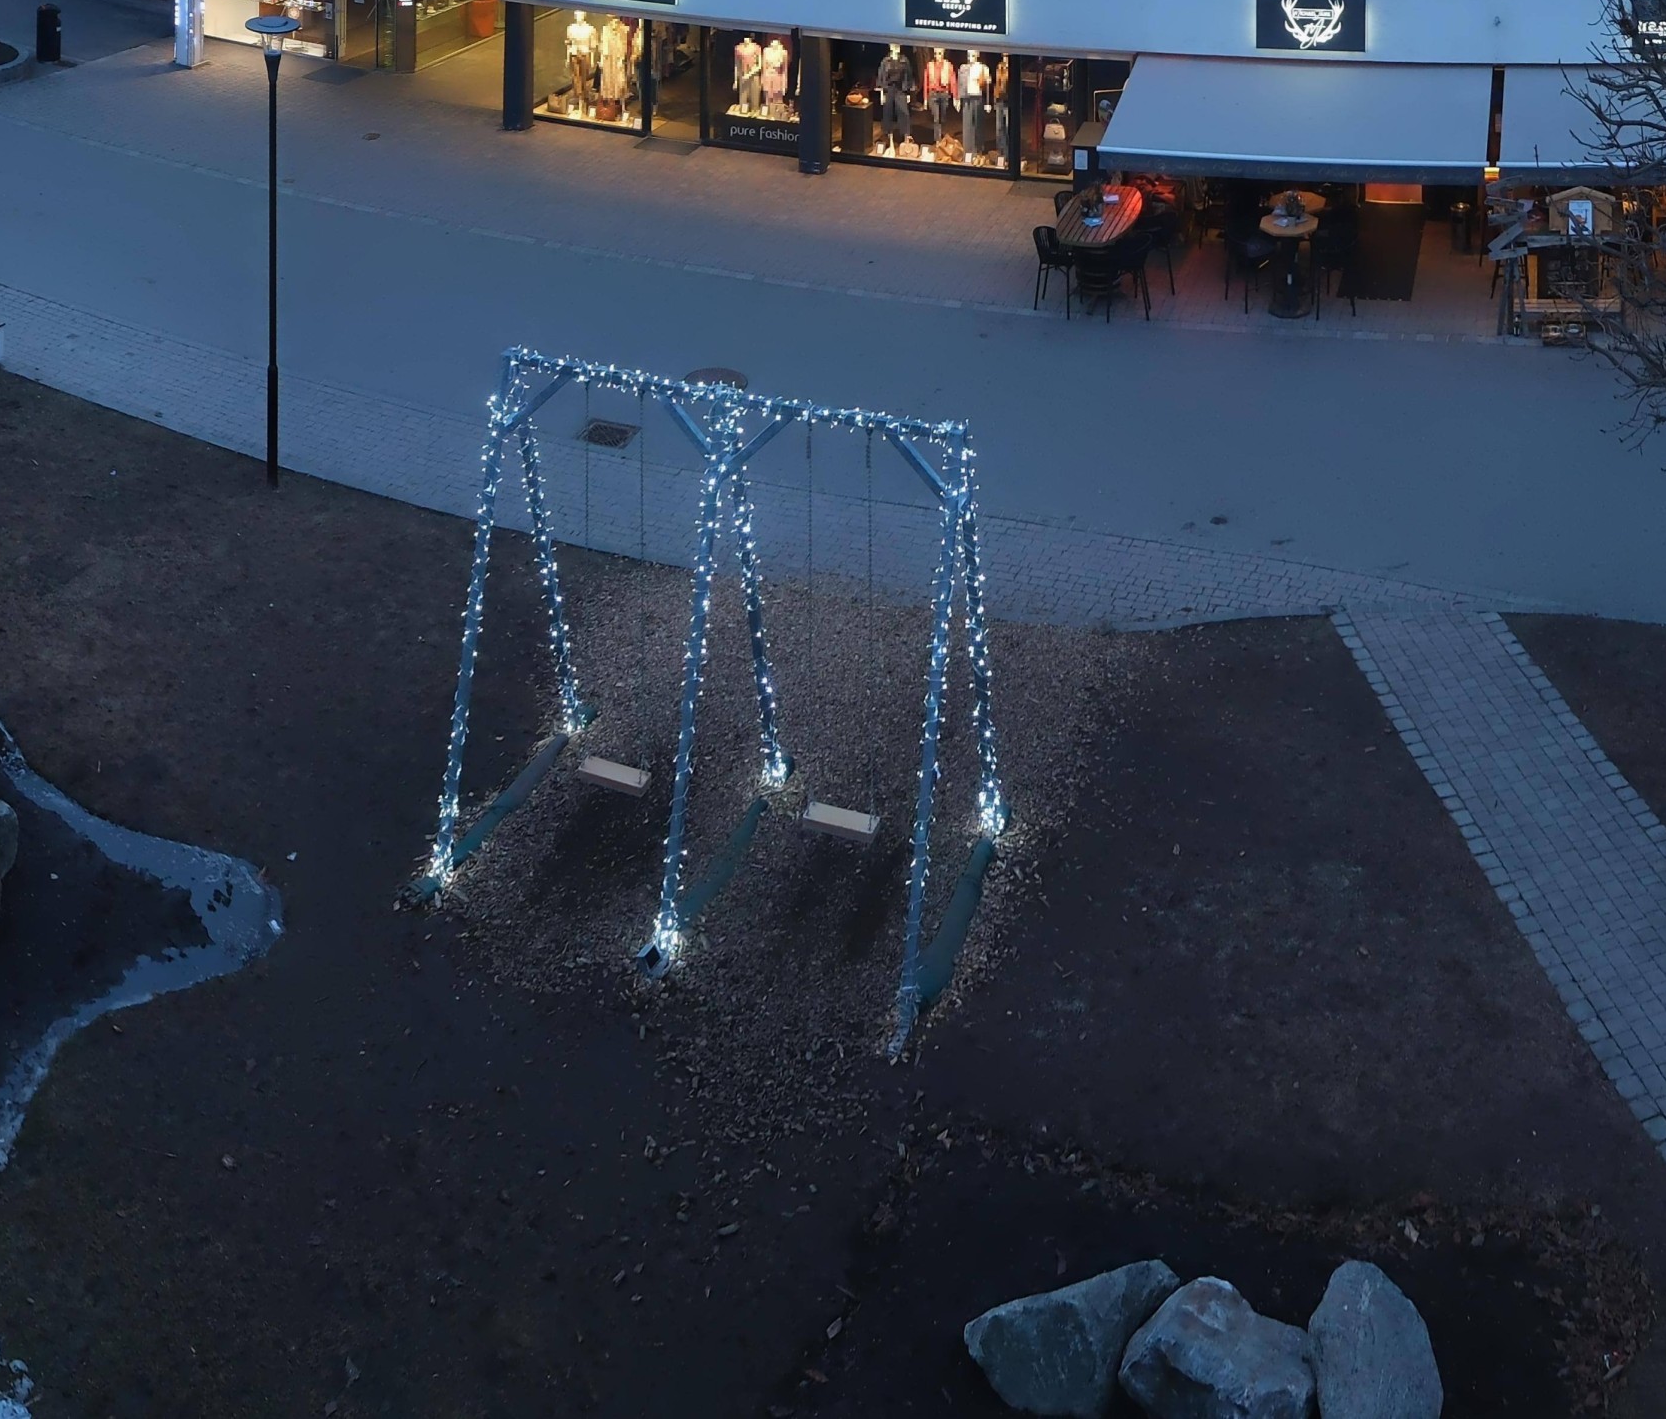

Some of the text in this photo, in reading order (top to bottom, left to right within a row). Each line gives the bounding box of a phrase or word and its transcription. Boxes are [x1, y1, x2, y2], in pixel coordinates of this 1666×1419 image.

[915, 18, 945, 27] SEEFELD
[946, 21, 982, 30] SHOPPING
[730, 125, 756, 137] pure
